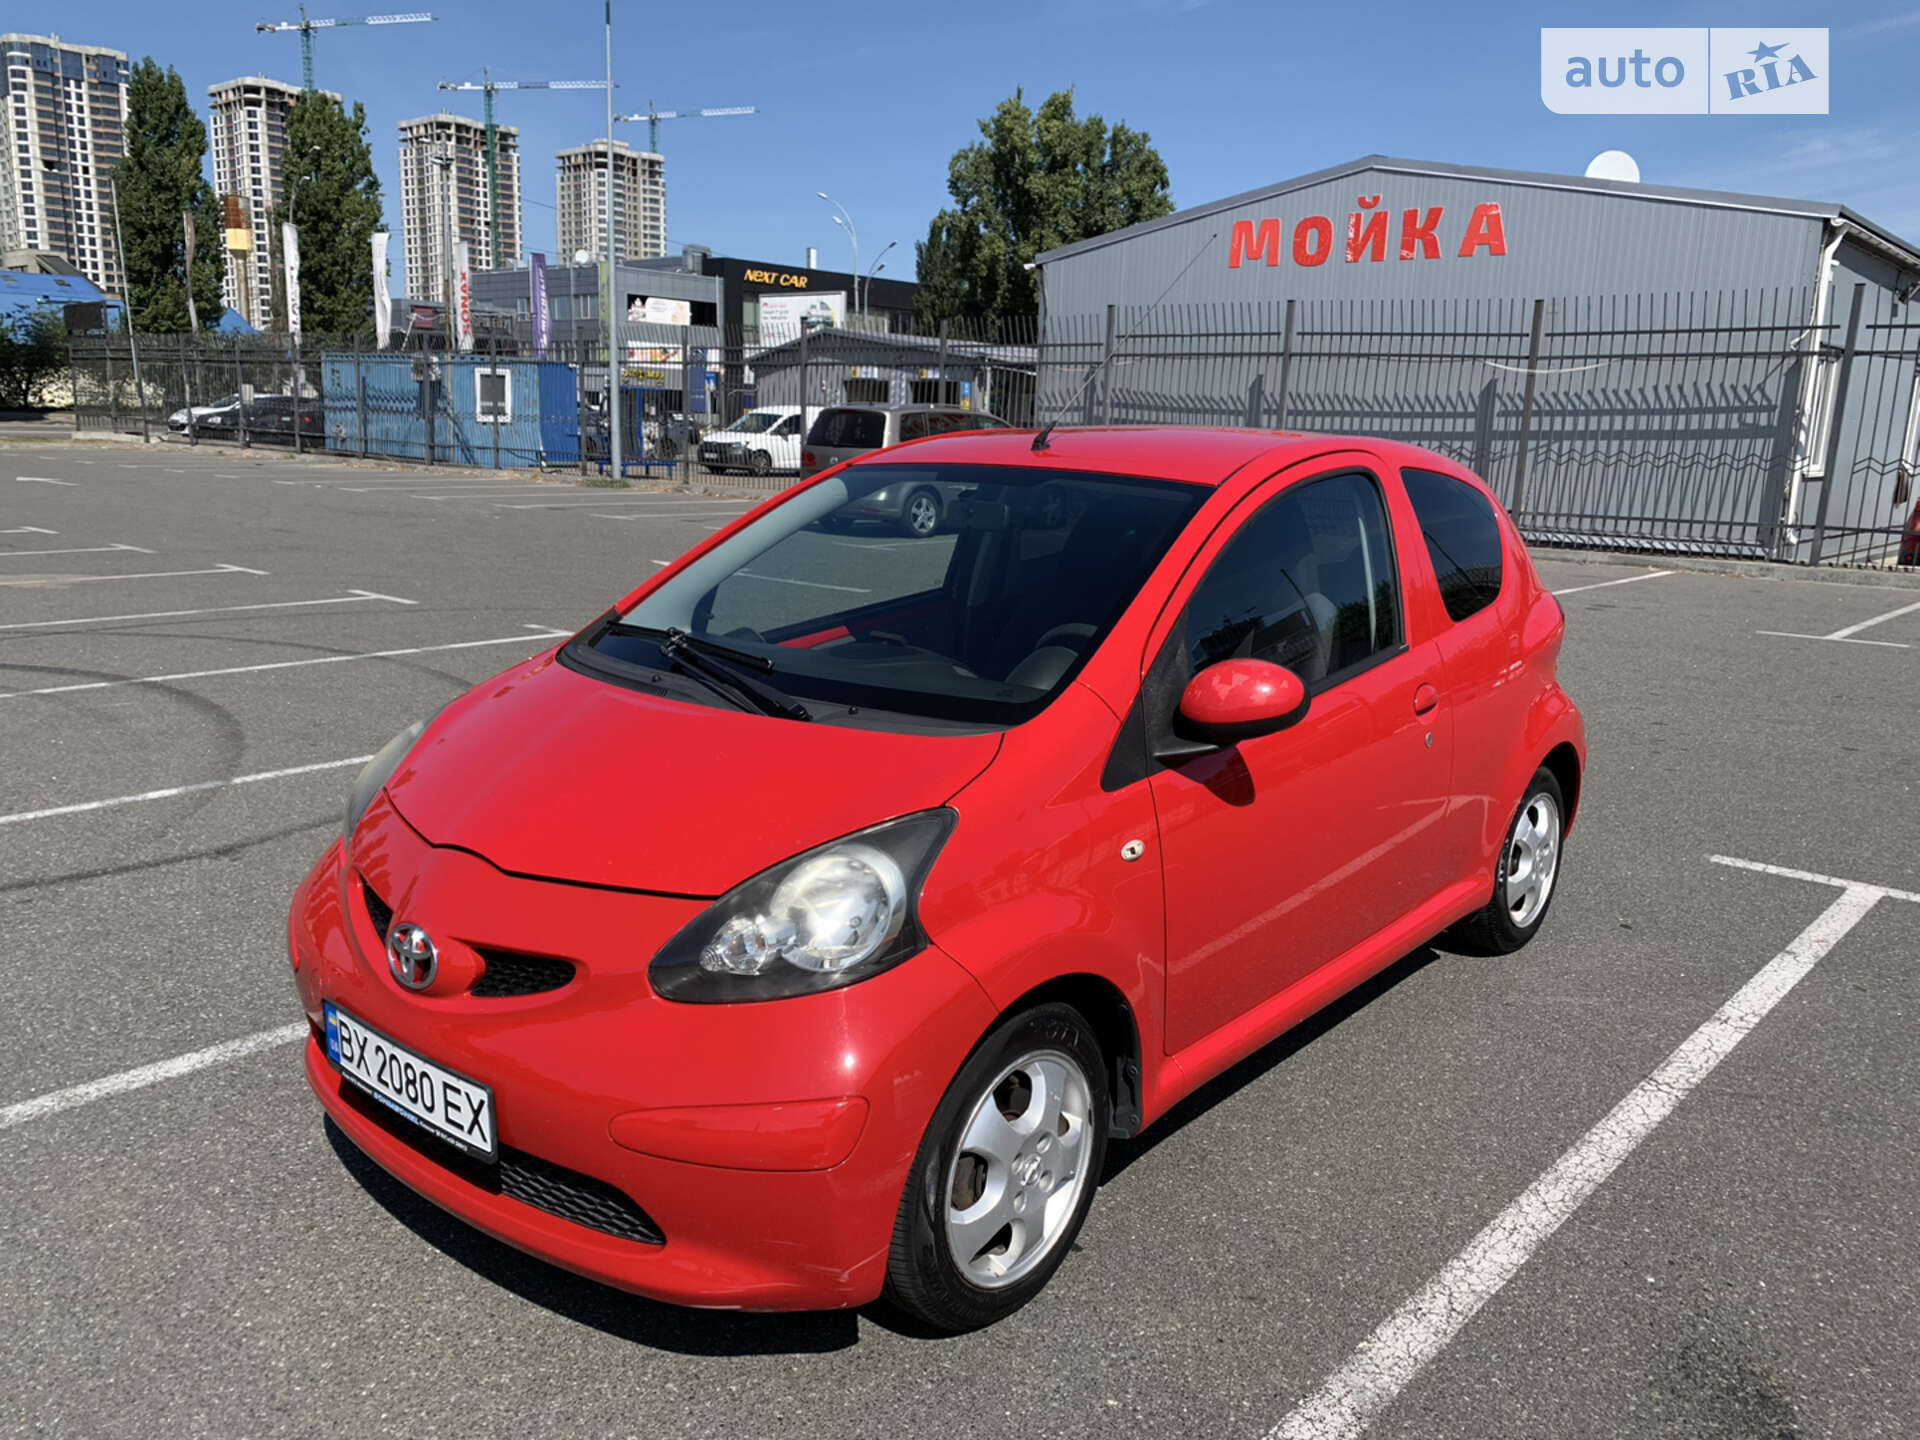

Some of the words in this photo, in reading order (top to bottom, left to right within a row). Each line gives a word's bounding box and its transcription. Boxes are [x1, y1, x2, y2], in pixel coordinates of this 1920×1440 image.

[1228, 195, 1507, 268] МОЙКА
[460, 271, 471, 336] SONAX
[539, 267, 548, 331] MICHELIN
[780, 274, 808, 289] CAR
[339, 1018, 371, 1077] BX
[375, 1045, 435, 1113] 2080
[443, 1081, 488, 1143] EX
